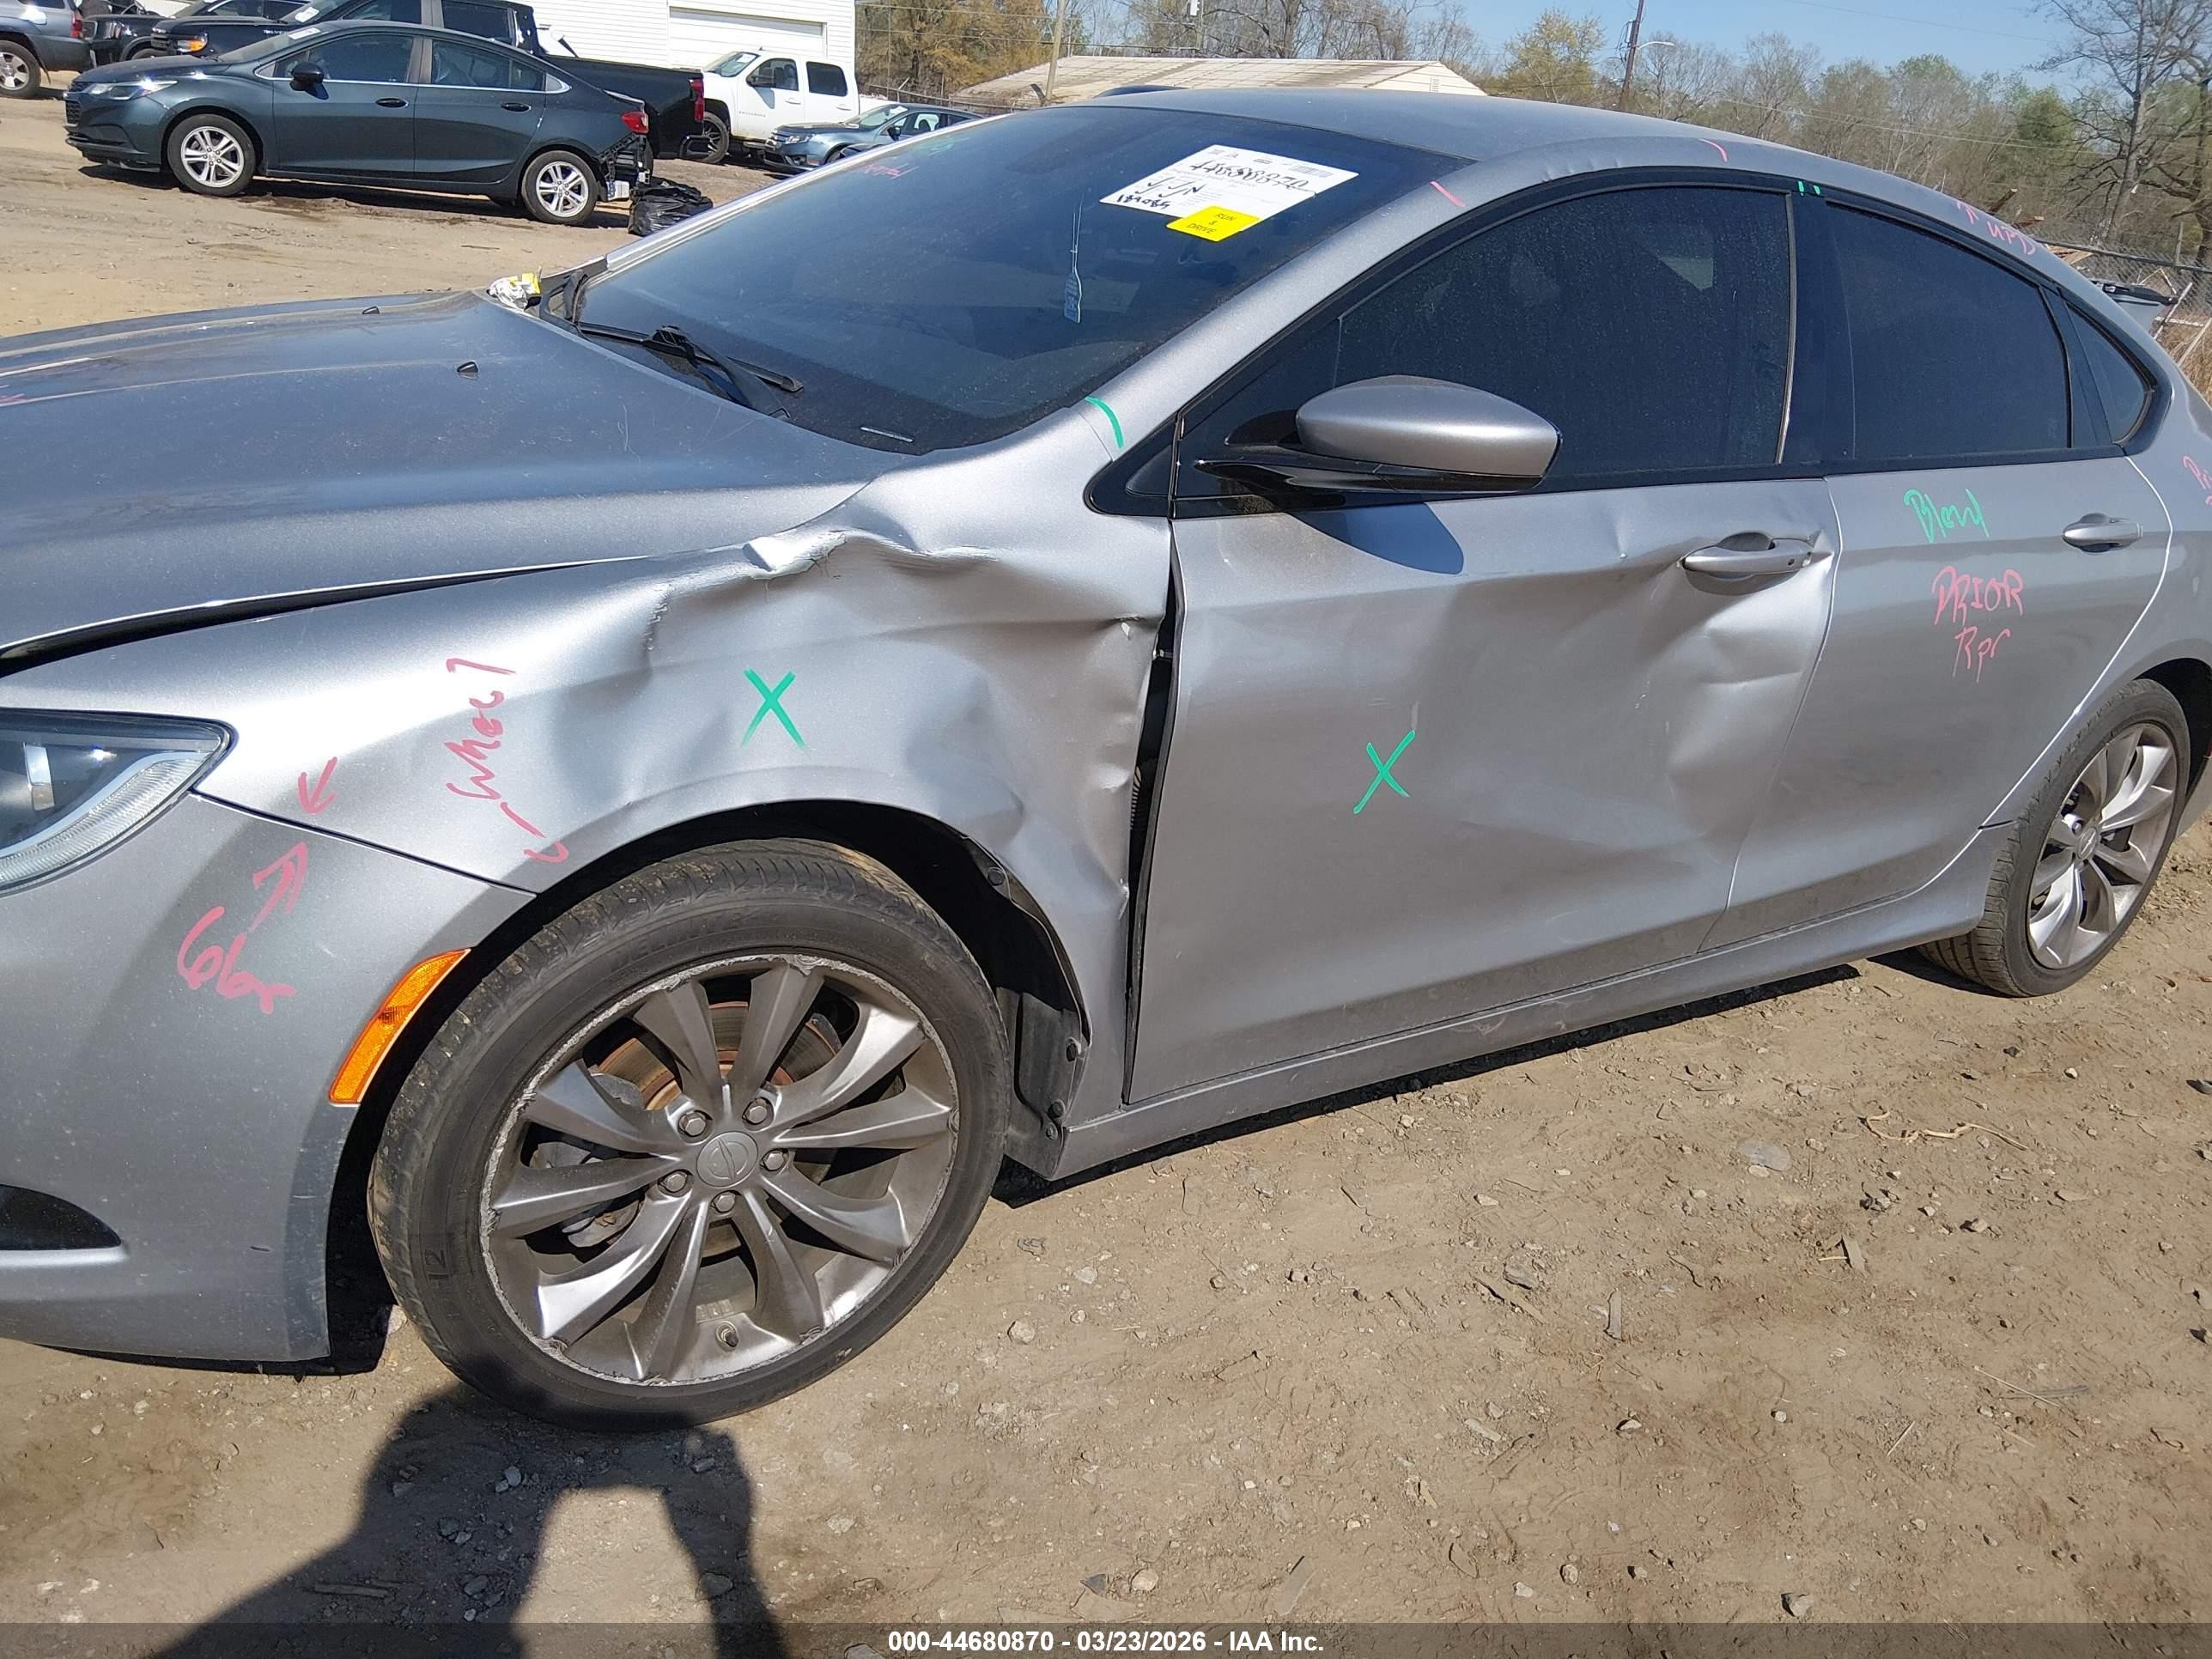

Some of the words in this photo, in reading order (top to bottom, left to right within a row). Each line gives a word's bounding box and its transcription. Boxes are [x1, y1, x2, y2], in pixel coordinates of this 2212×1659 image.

[1214, 212, 1237, 222] RUN
[1188, 222, 1217, 234] DRIVE
[1931, 565, 2024, 626] PRIOR
